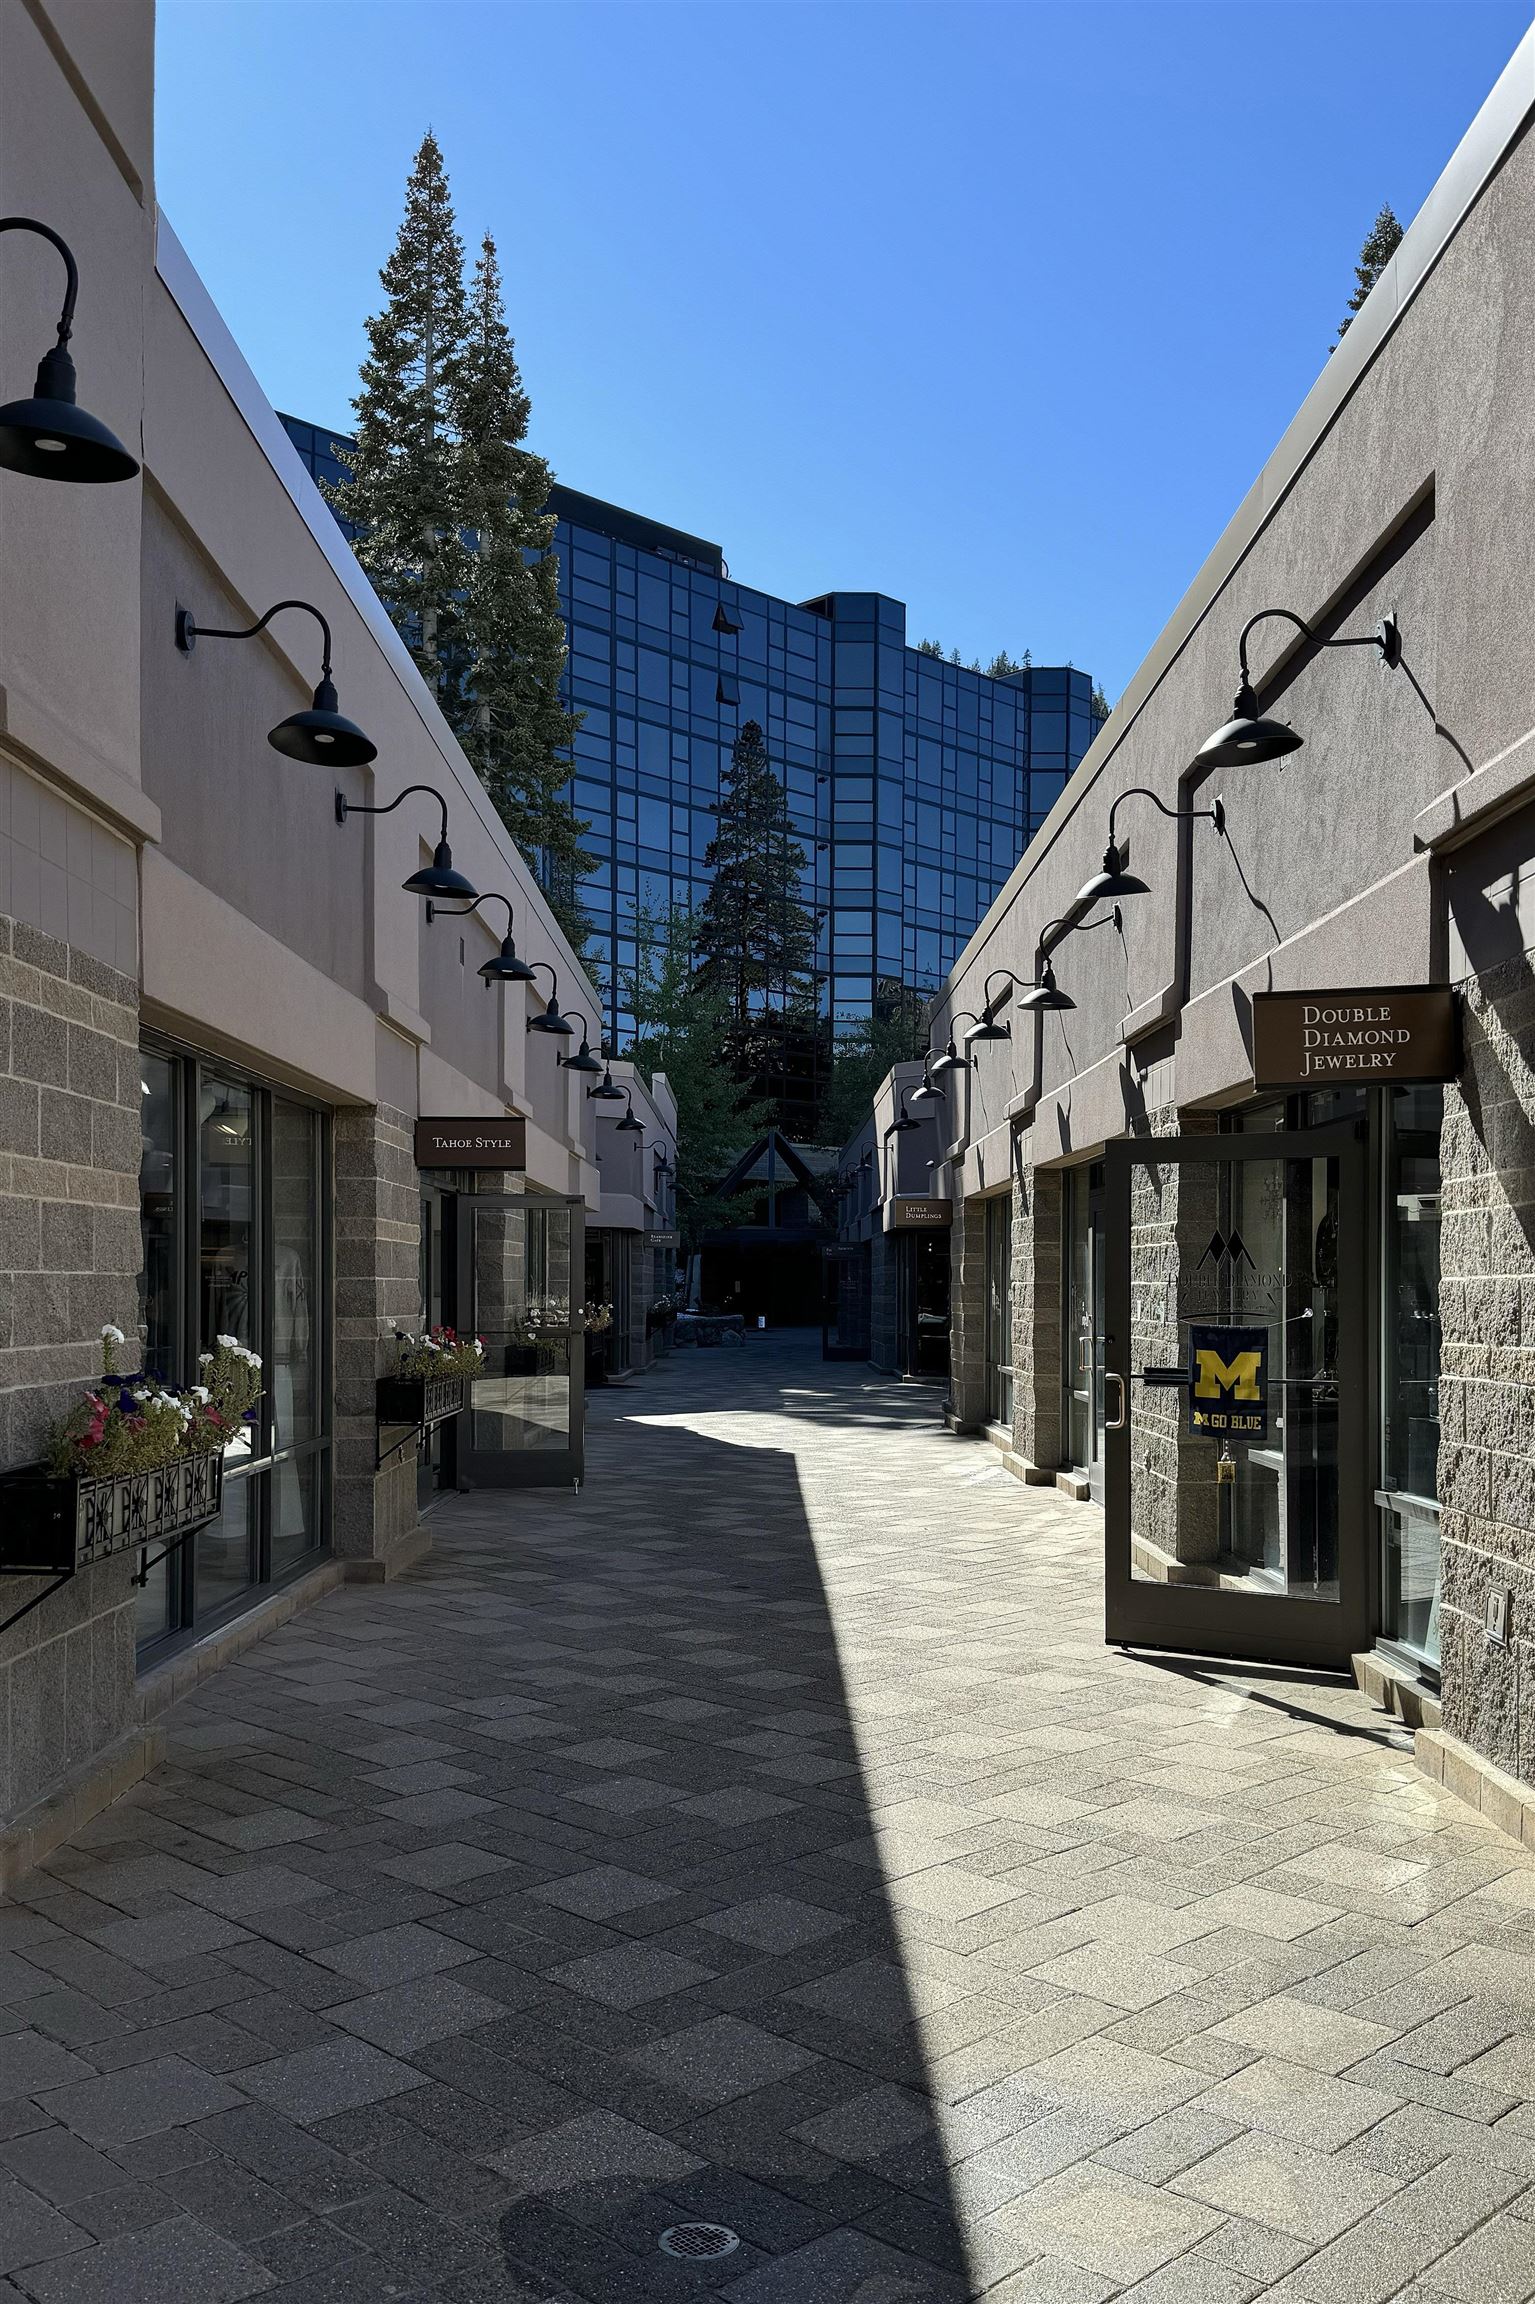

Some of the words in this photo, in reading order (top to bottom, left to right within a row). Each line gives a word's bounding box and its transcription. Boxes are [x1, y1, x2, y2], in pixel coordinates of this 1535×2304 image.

[1302, 1006, 1391, 1024] DOUBLE
[1303, 1029, 1411, 1048] DIAMOND
[1300, 1052, 1397, 1076] JEWELRY
[432, 1137, 472, 1148] TAHOE
[475, 1137, 511, 1148] STYLE
[1195, 1349, 1262, 1400] M
[1211, 1414, 1227, 1428] GO
[1231, 1415, 1262, 1430] BLUE
